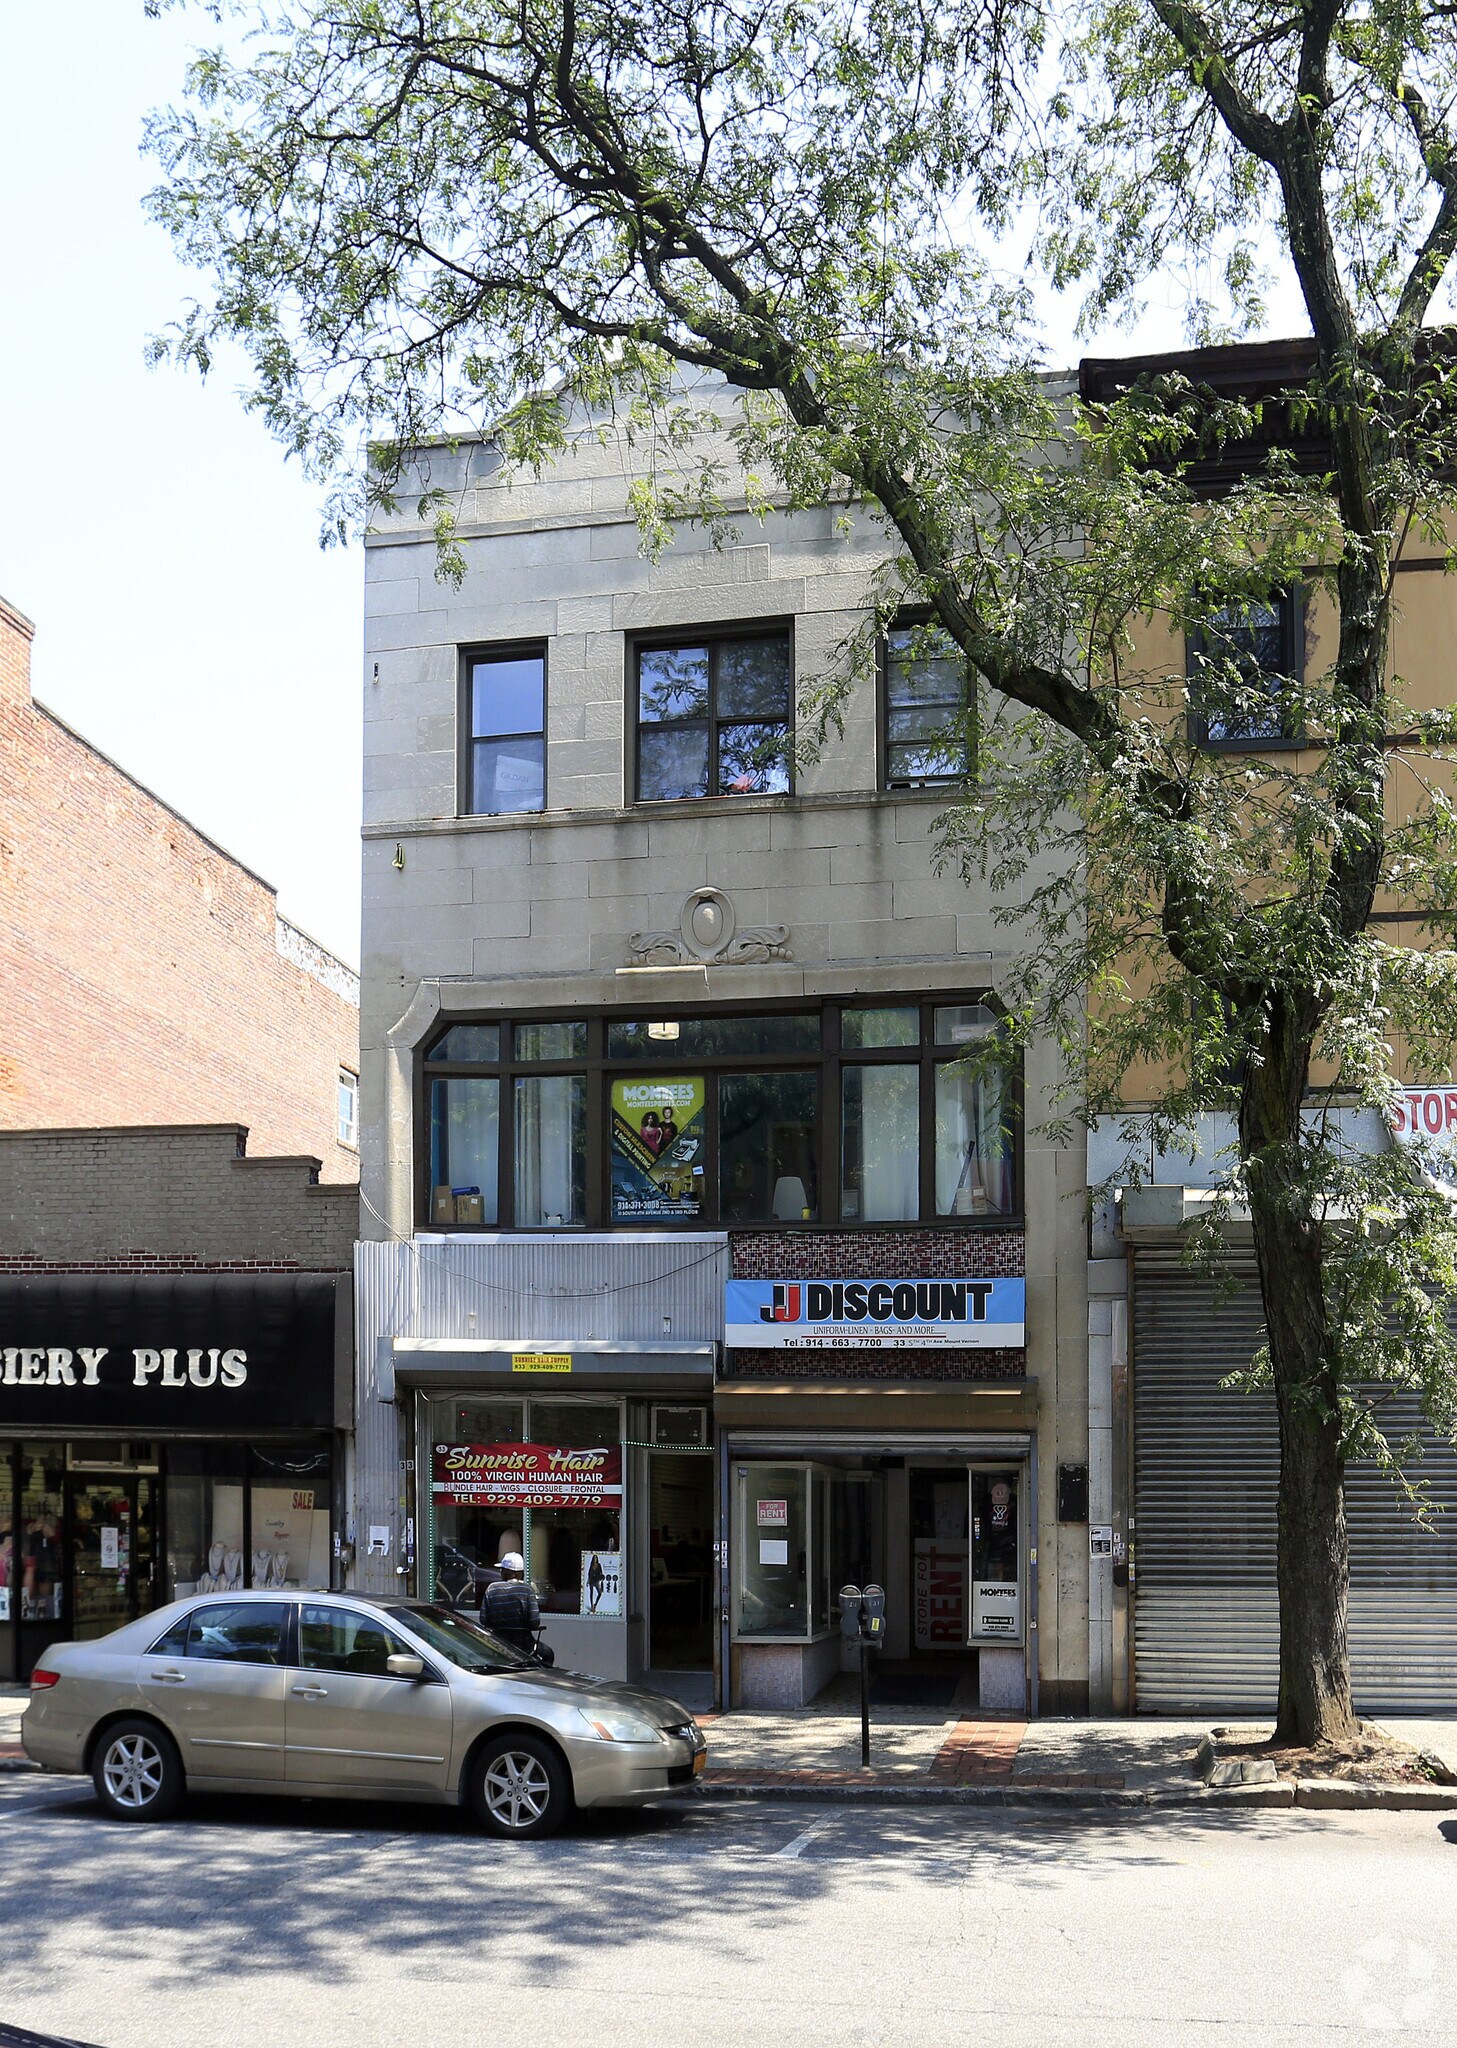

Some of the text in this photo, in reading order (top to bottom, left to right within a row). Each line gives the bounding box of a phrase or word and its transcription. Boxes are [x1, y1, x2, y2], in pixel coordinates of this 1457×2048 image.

[613, 1118, 633, 1138] CUSTOM
[616, 1132, 634, 1150] DIGITAL
[630, 1147, 652, 1169] PRINTING
[760, 1282, 994, 1323] JJ DISCOUNT
[897, 1326, 912, 1335] AND
[805, 1339, 823, 1347] 914
[831, 1339, 850, 1347] 663
[858, 1339, 882, 1347] 7700
[893, 1339, 906, 1347] 33
[0, 1348, 248, 1387] IERY PLUS
[444, 1446, 609, 1472] Sunrise Hair
[450, 1471, 603, 1483] 100% VIRGIN HUMAN HAIR
[443, 1482, 474, 1492] BUNDLE
[476, 1484, 493, 1492] HAIR
[500, 1484, 520, 1492] WIGS
[527, 1485, 563, 1493] CLOSURE
[570, 1485, 606, 1493] FRONTAL
[292, 1491, 313, 1510] SALE
[452, 1494, 602, 1505] TEL: 929-409-7779
[759, 1509, 785, 1518] RENT
[917, 1551, 928, 1637] STORE FOR
[929, 1545, 963, 1642] RENT
[980, 1588, 1017, 1597] MONTEES
